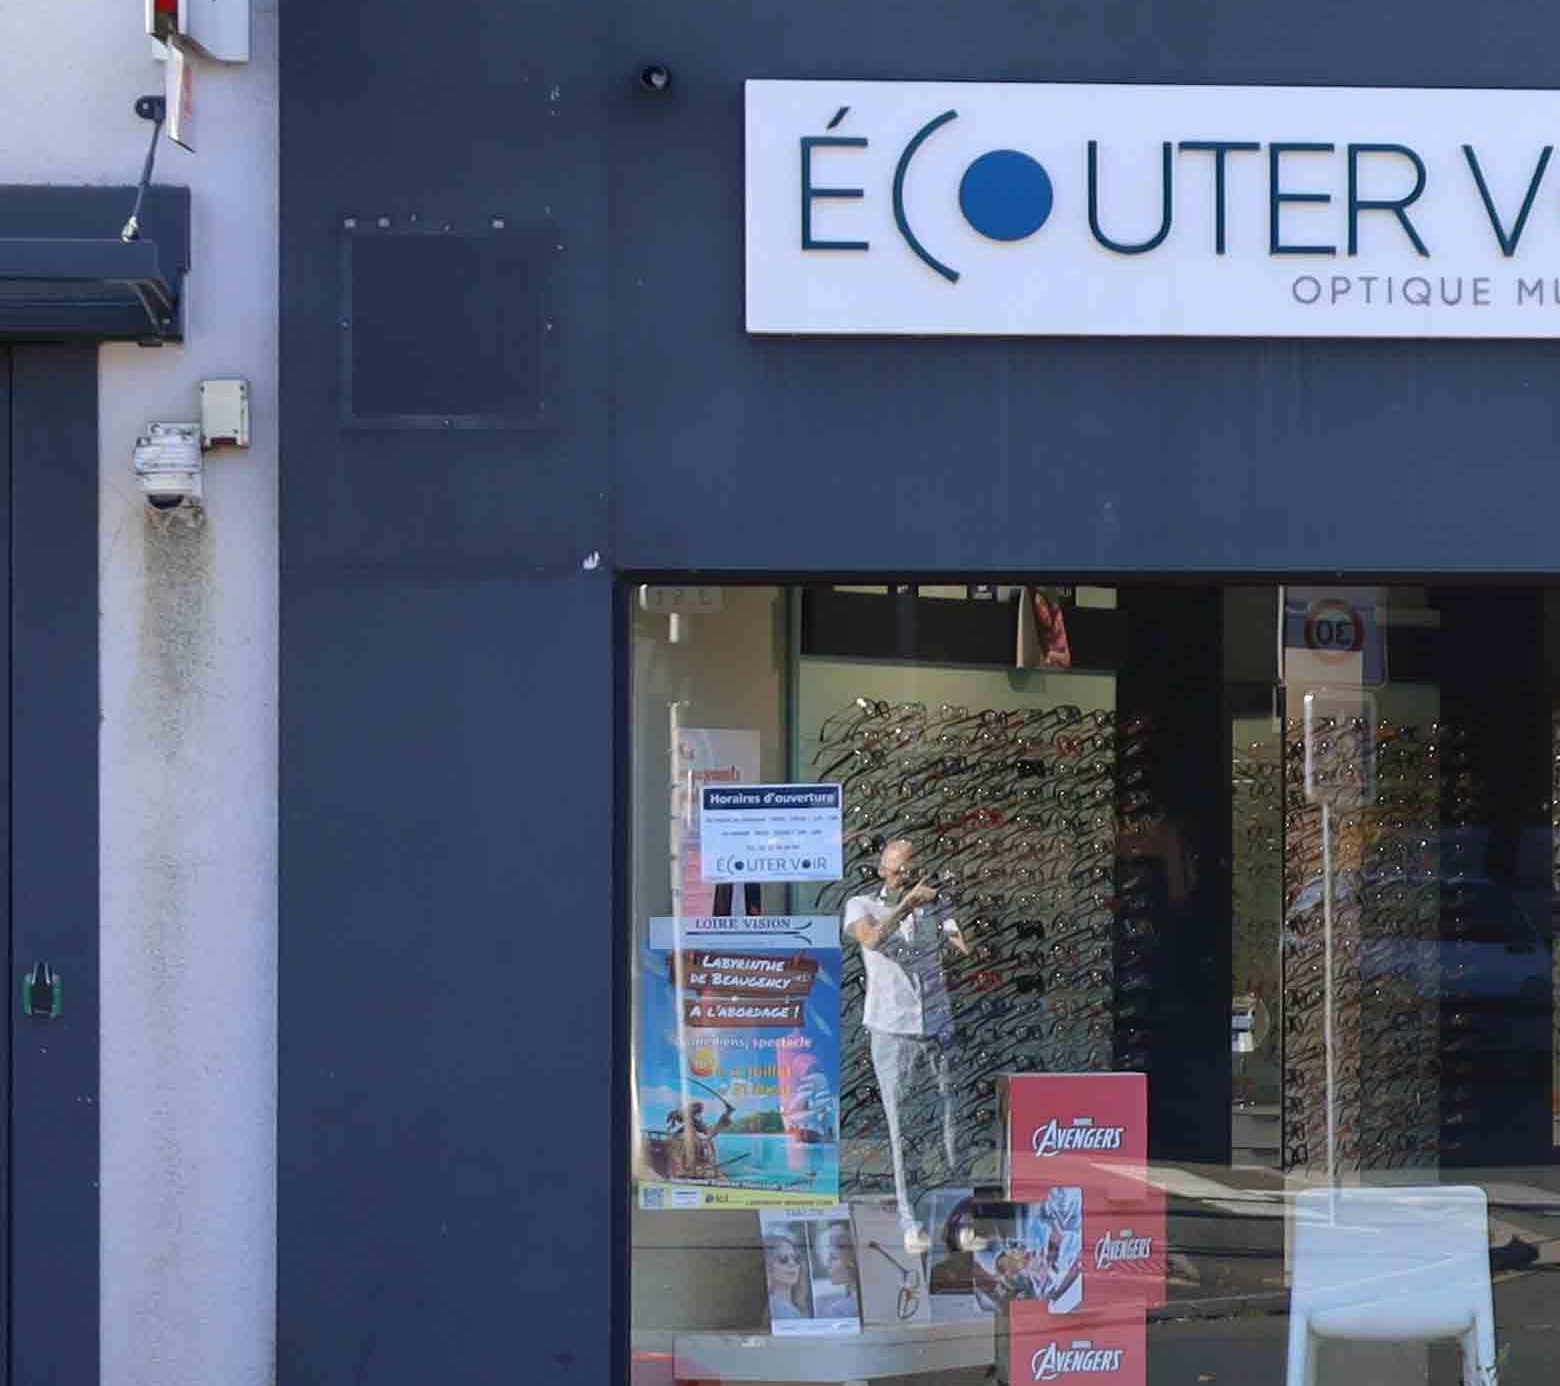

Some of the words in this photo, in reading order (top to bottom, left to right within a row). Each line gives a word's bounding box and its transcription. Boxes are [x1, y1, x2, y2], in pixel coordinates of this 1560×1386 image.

[799, 106, 1430, 285] ÉCOUTER
[1290, 274, 1491, 308] OPTIQUE
[709, 793, 760, 805] Horaires
[764, 791, 836, 804] d'ouverture
[695, 918, 738, 929] LOIRE
[742, 917, 792, 929] VISION
[702, 955, 785, 972] LABYRINTHE
[689, 973, 705, 984] DE
[711, 973, 792, 989] BEAUGENCY
[707, 1005, 790, 1018] L'ABORDAGE
[1032, 1117, 1126, 1157] AVENGERS
[1095, 1229, 1152, 1269] AVENGERS
[1031, 1341, 1124, 1381] AVENGERS
